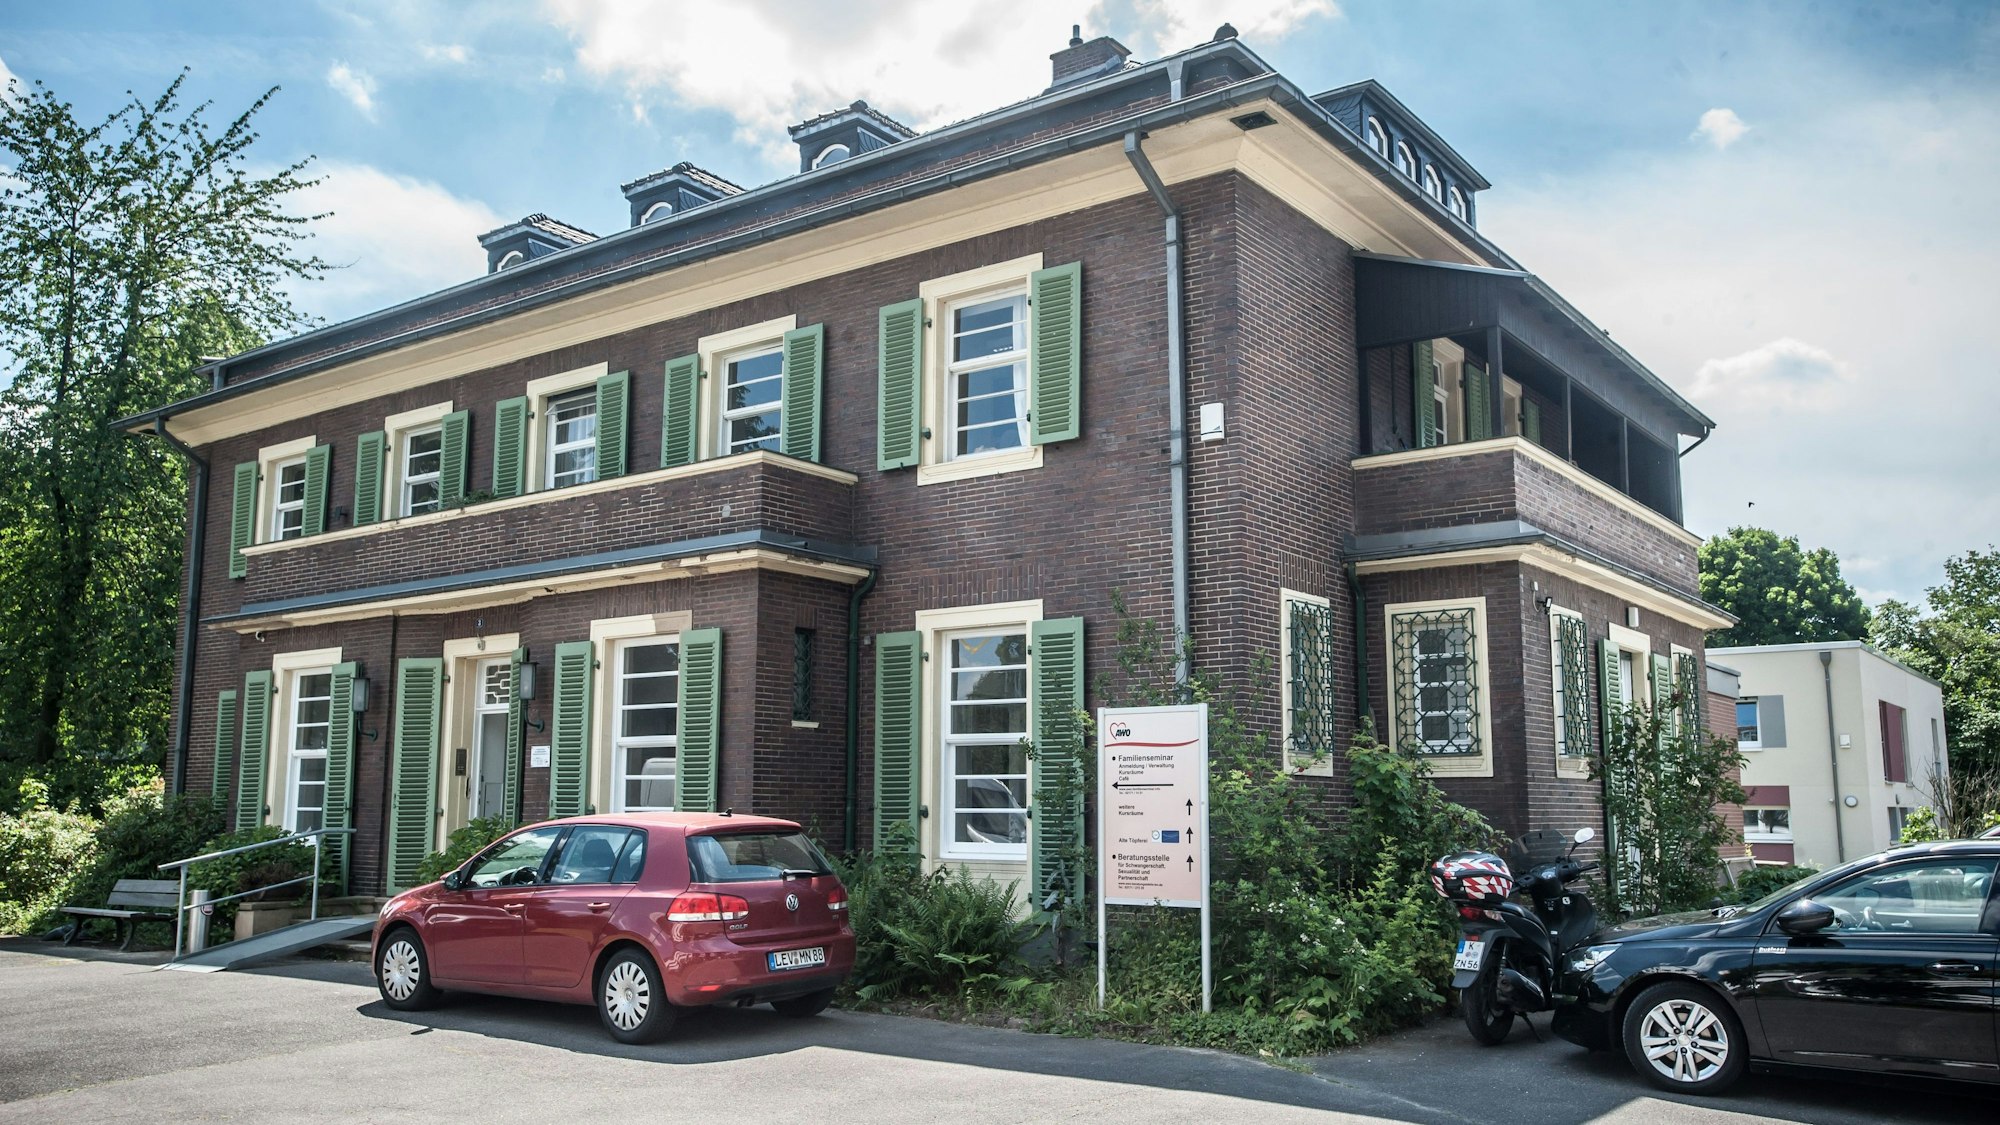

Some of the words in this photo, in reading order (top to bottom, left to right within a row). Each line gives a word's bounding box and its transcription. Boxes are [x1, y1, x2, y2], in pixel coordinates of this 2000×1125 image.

[1118, 854, 1170, 862] Beratungsstelle
[1469, 942, 1474, 950] K
[774, 952, 794, 966] LEV
[800, 950, 811, 963] MN
[814, 949, 824, 962] 88
